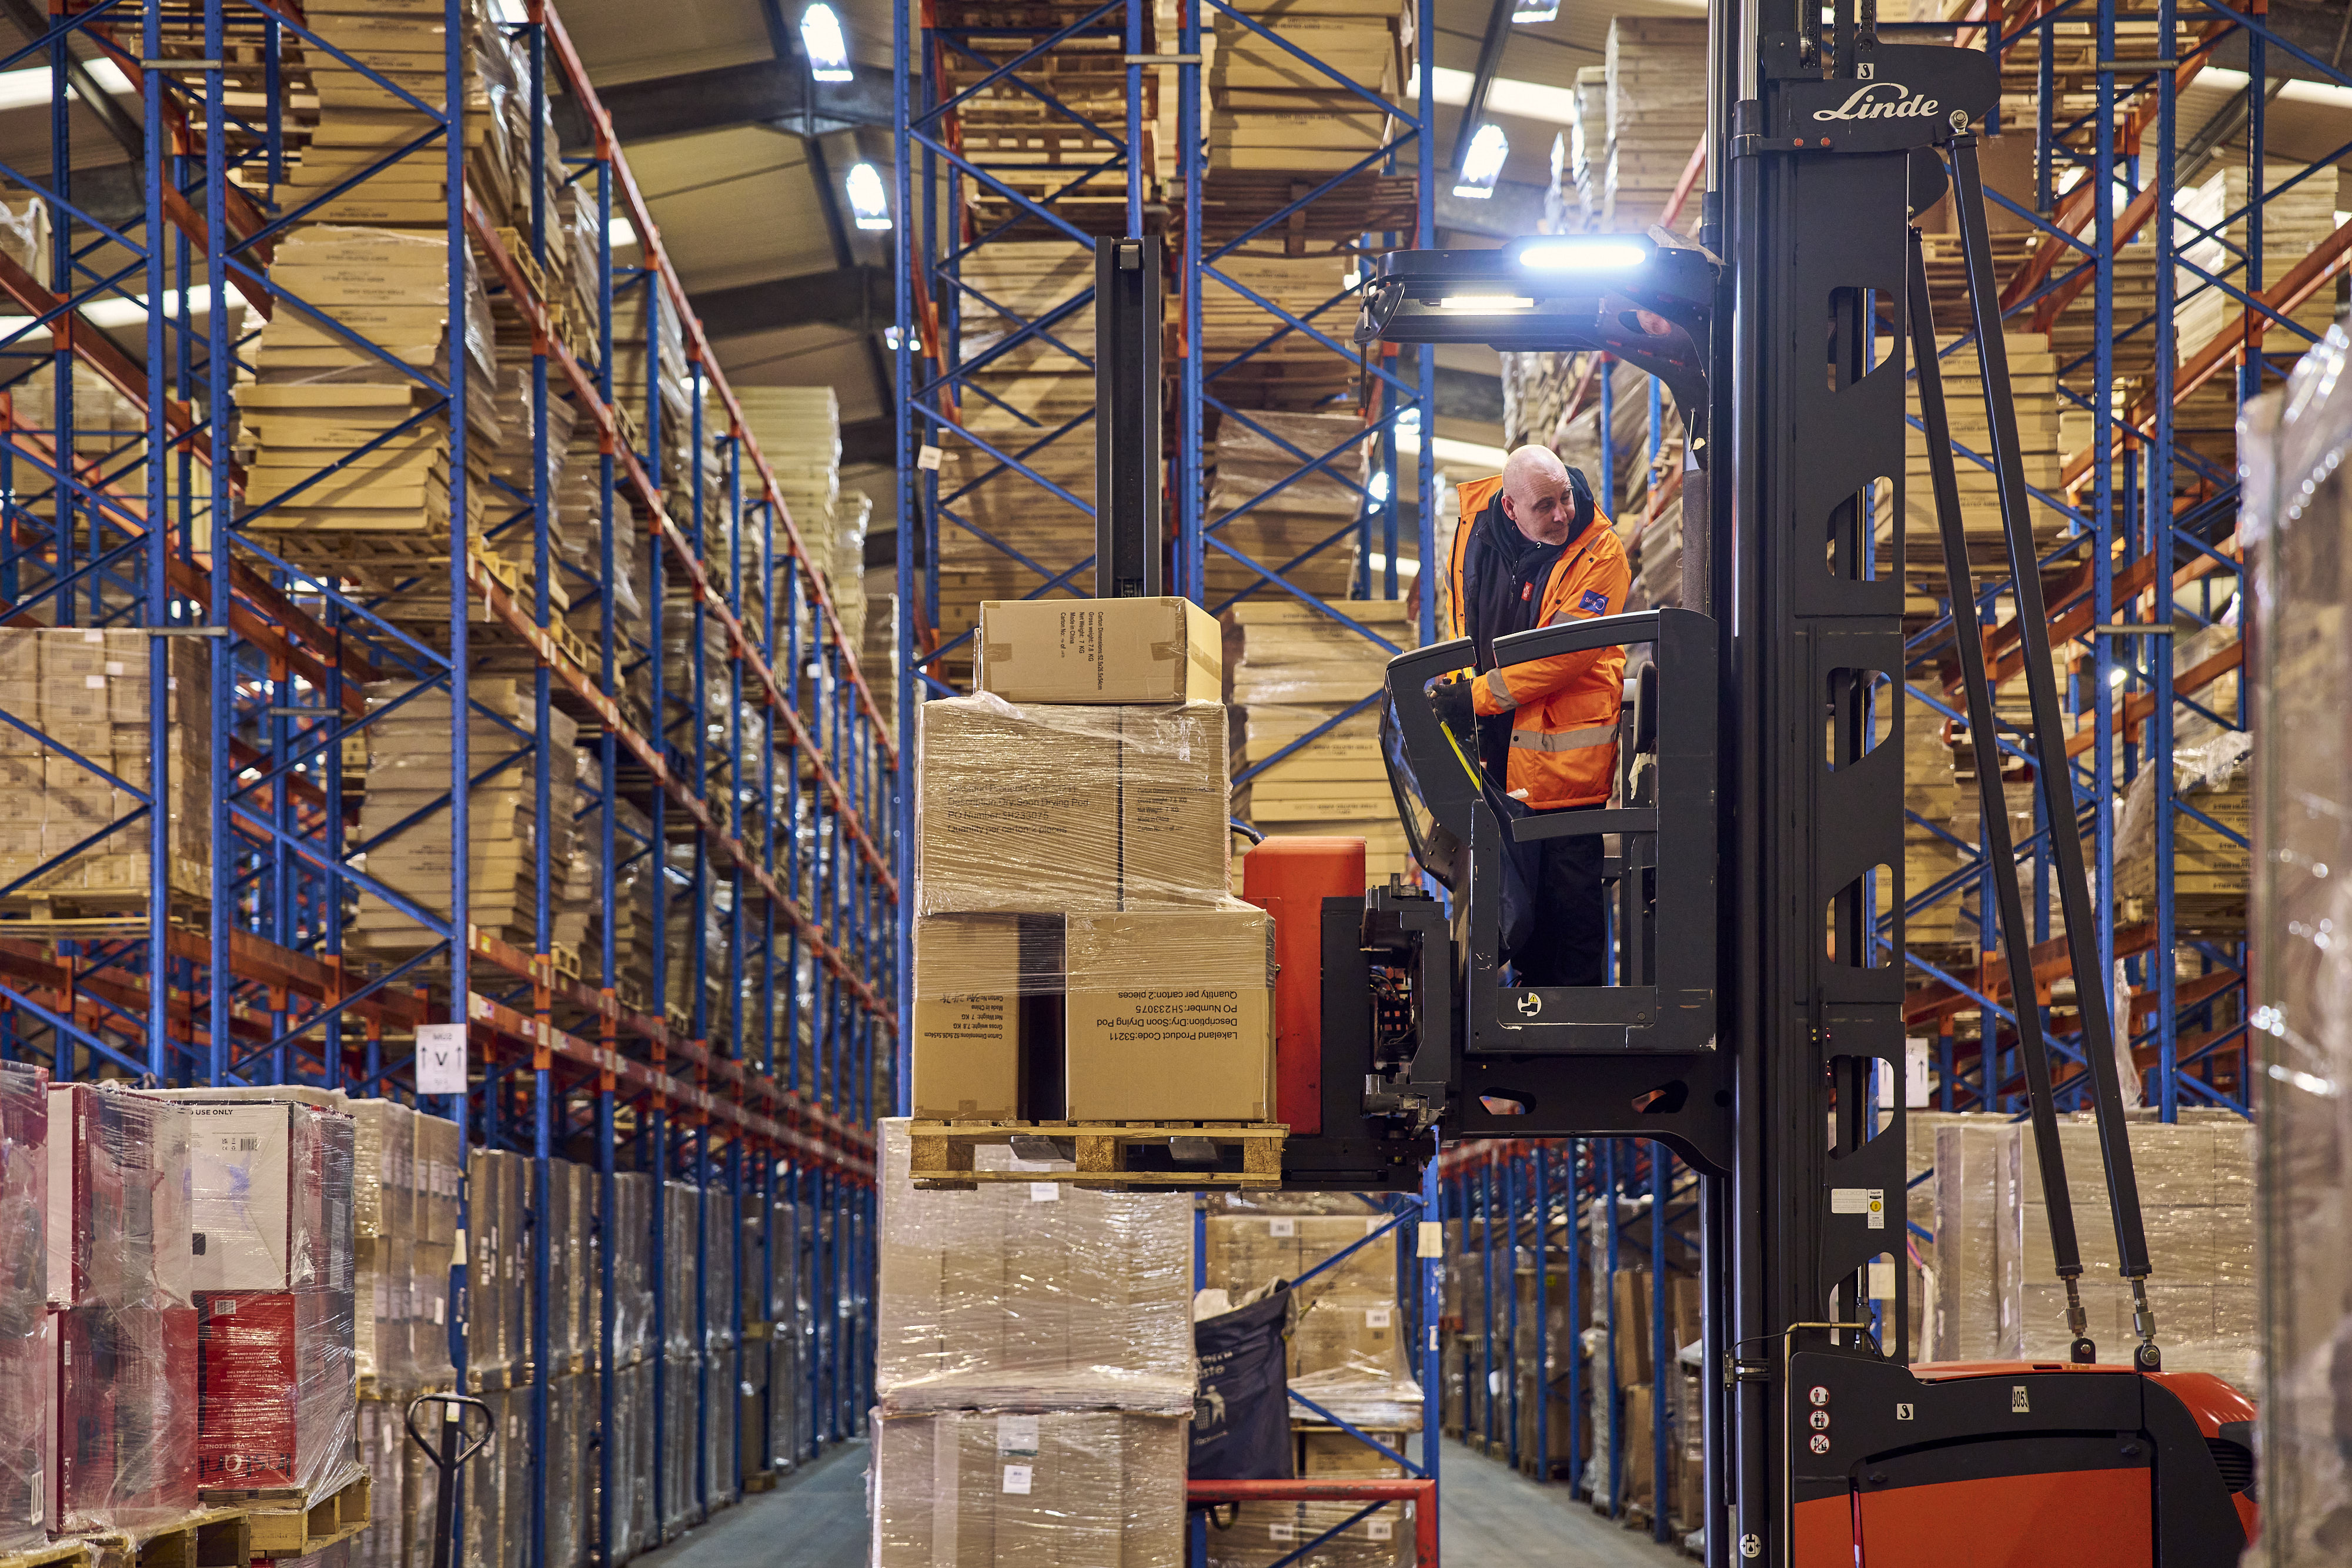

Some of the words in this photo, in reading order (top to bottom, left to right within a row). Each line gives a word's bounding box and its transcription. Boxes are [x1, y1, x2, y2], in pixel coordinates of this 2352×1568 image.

[1813, 82, 1938, 121] Linde
[1118, 990, 1146, 999] pieces
[1148, 991, 1183, 999] carton:2
[1185, 990, 1199, 998] per
[1201, 990, 1237, 999] Quantity
[1116, 1017, 1144, 1027] Drying
[1146, 1017, 1237, 1027] Description:Dry:Soon
[1110, 1032, 1161, 1041] Code:53211
[1163, 1032, 1196, 1040] Product
[1198, 1032, 1237, 1040] Lakeland
[435, 1051, 447, 1065] V
